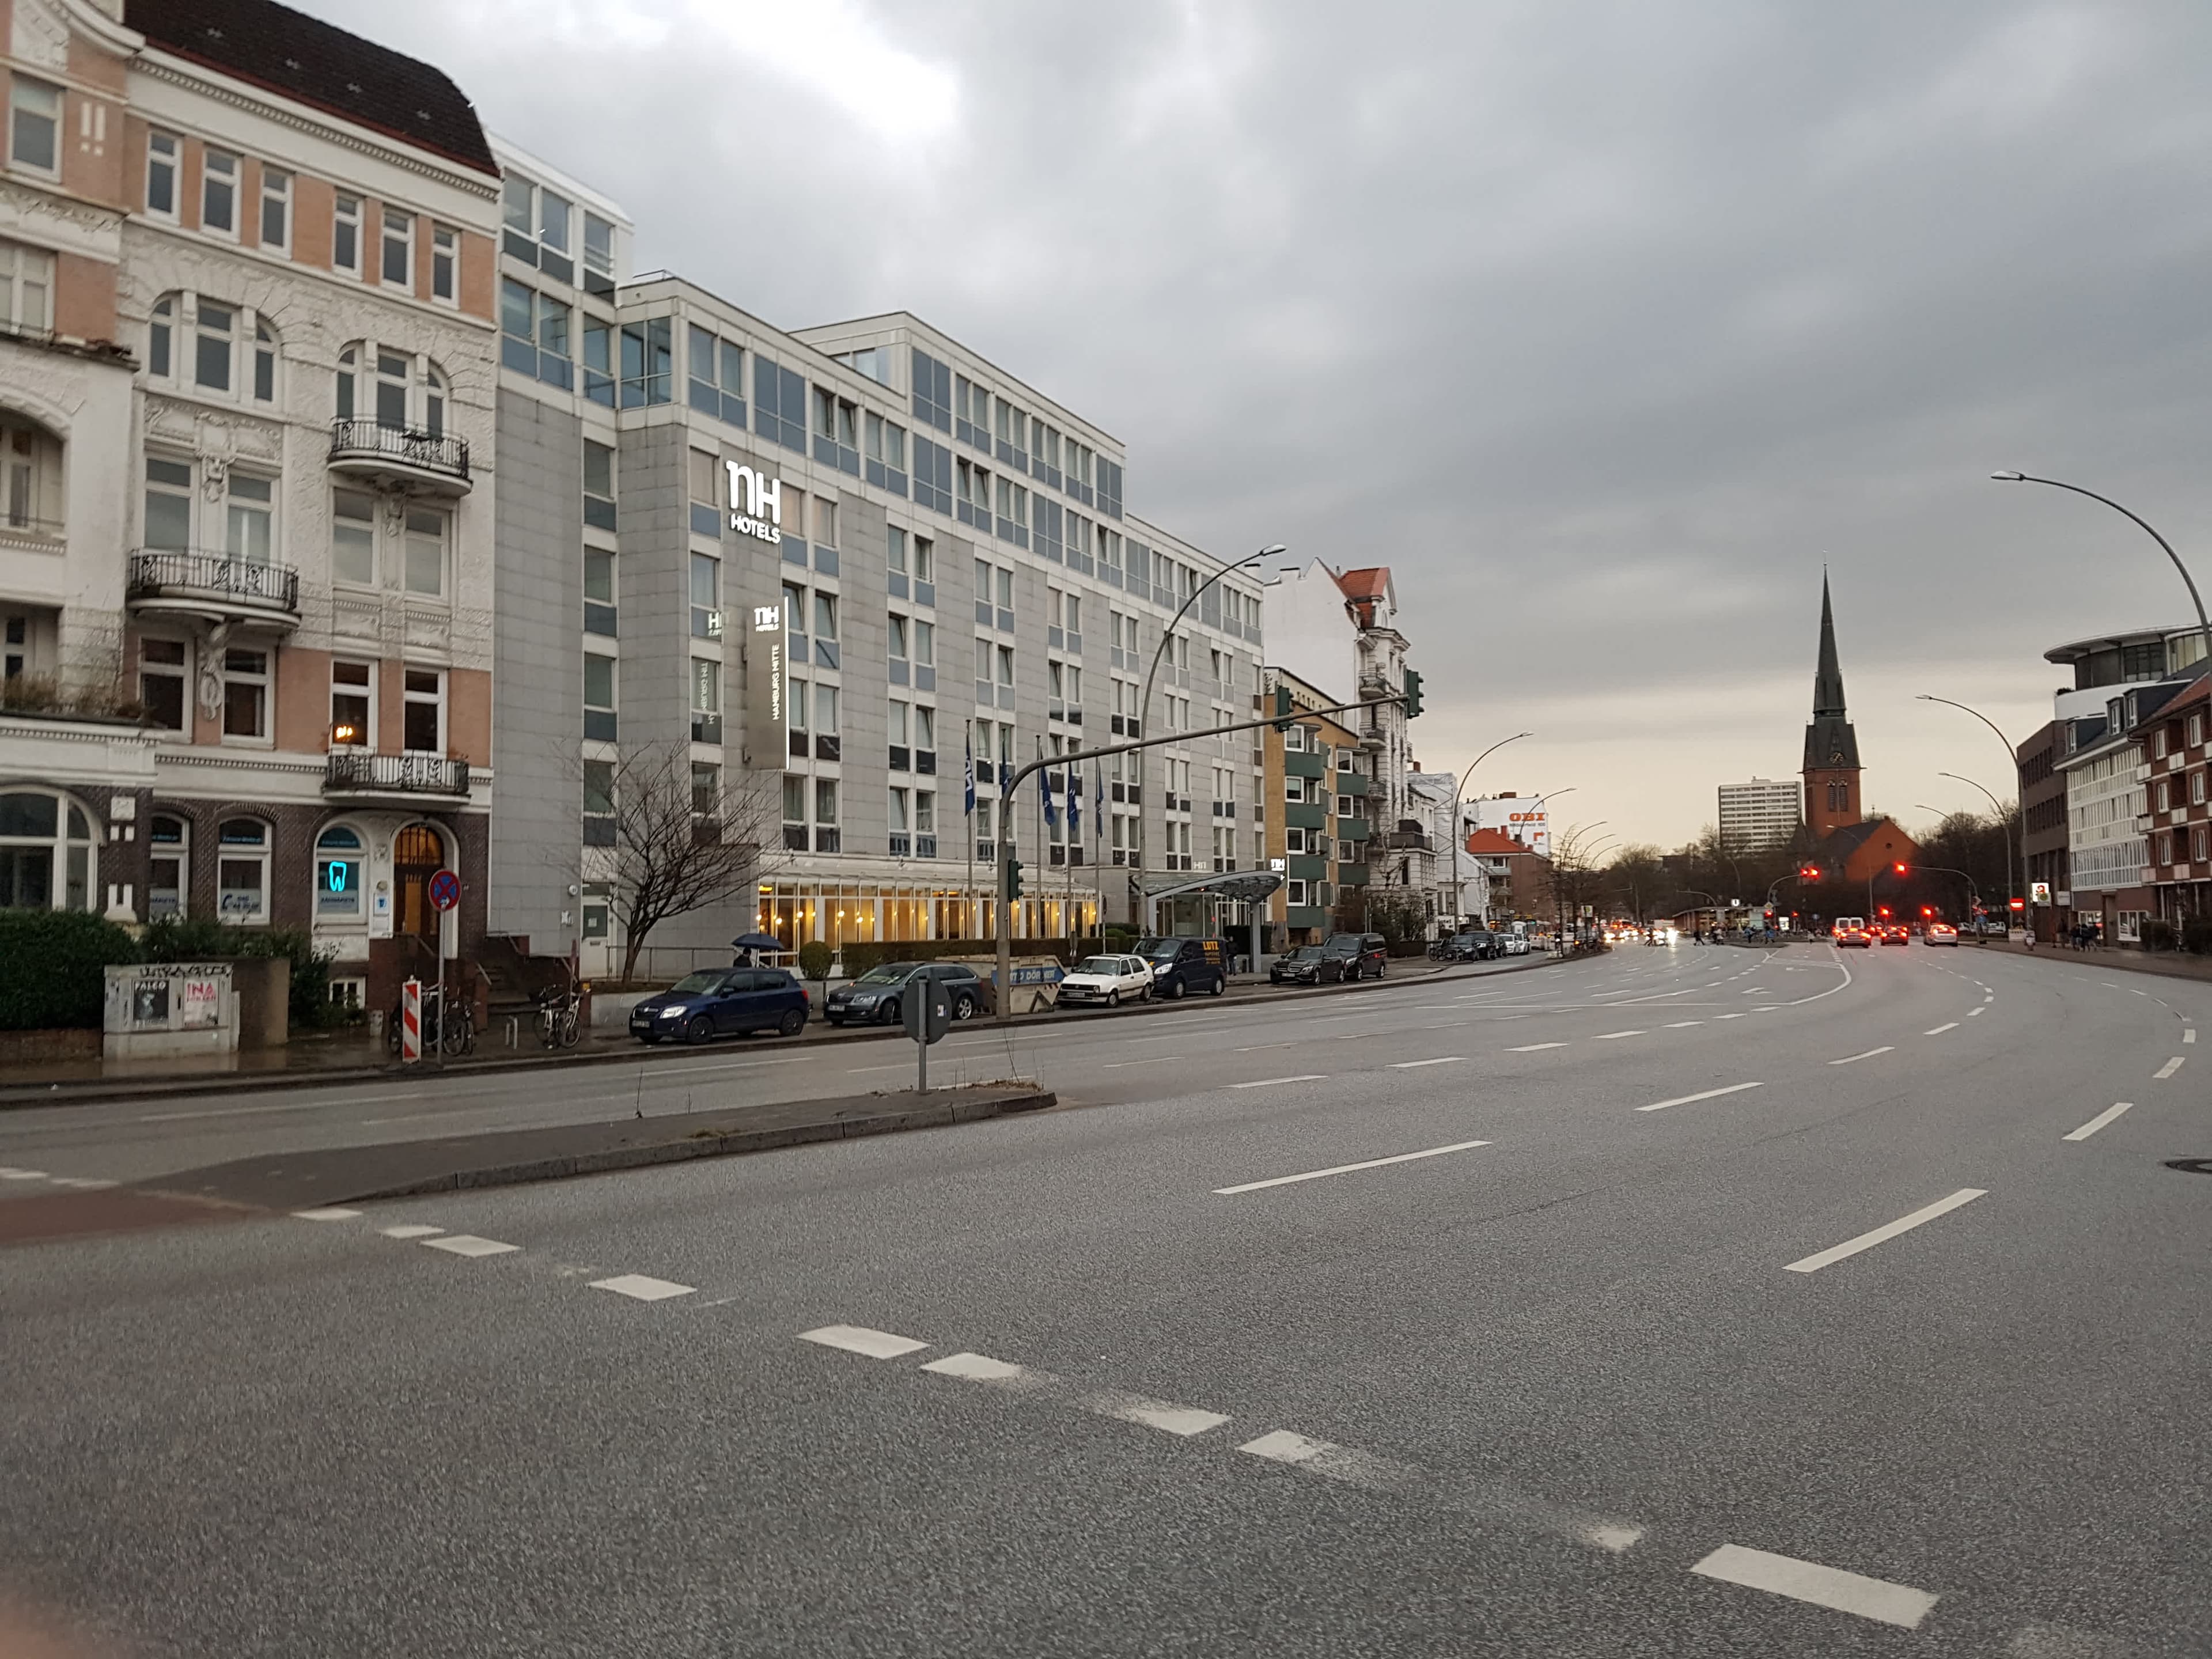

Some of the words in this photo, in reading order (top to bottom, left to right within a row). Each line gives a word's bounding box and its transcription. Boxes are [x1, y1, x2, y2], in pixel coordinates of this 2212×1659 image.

[730, 513, 781, 544] HOTELS
[772, 672, 780, 720] HAMBURG
[1509, 813, 1545, 821] OBI
